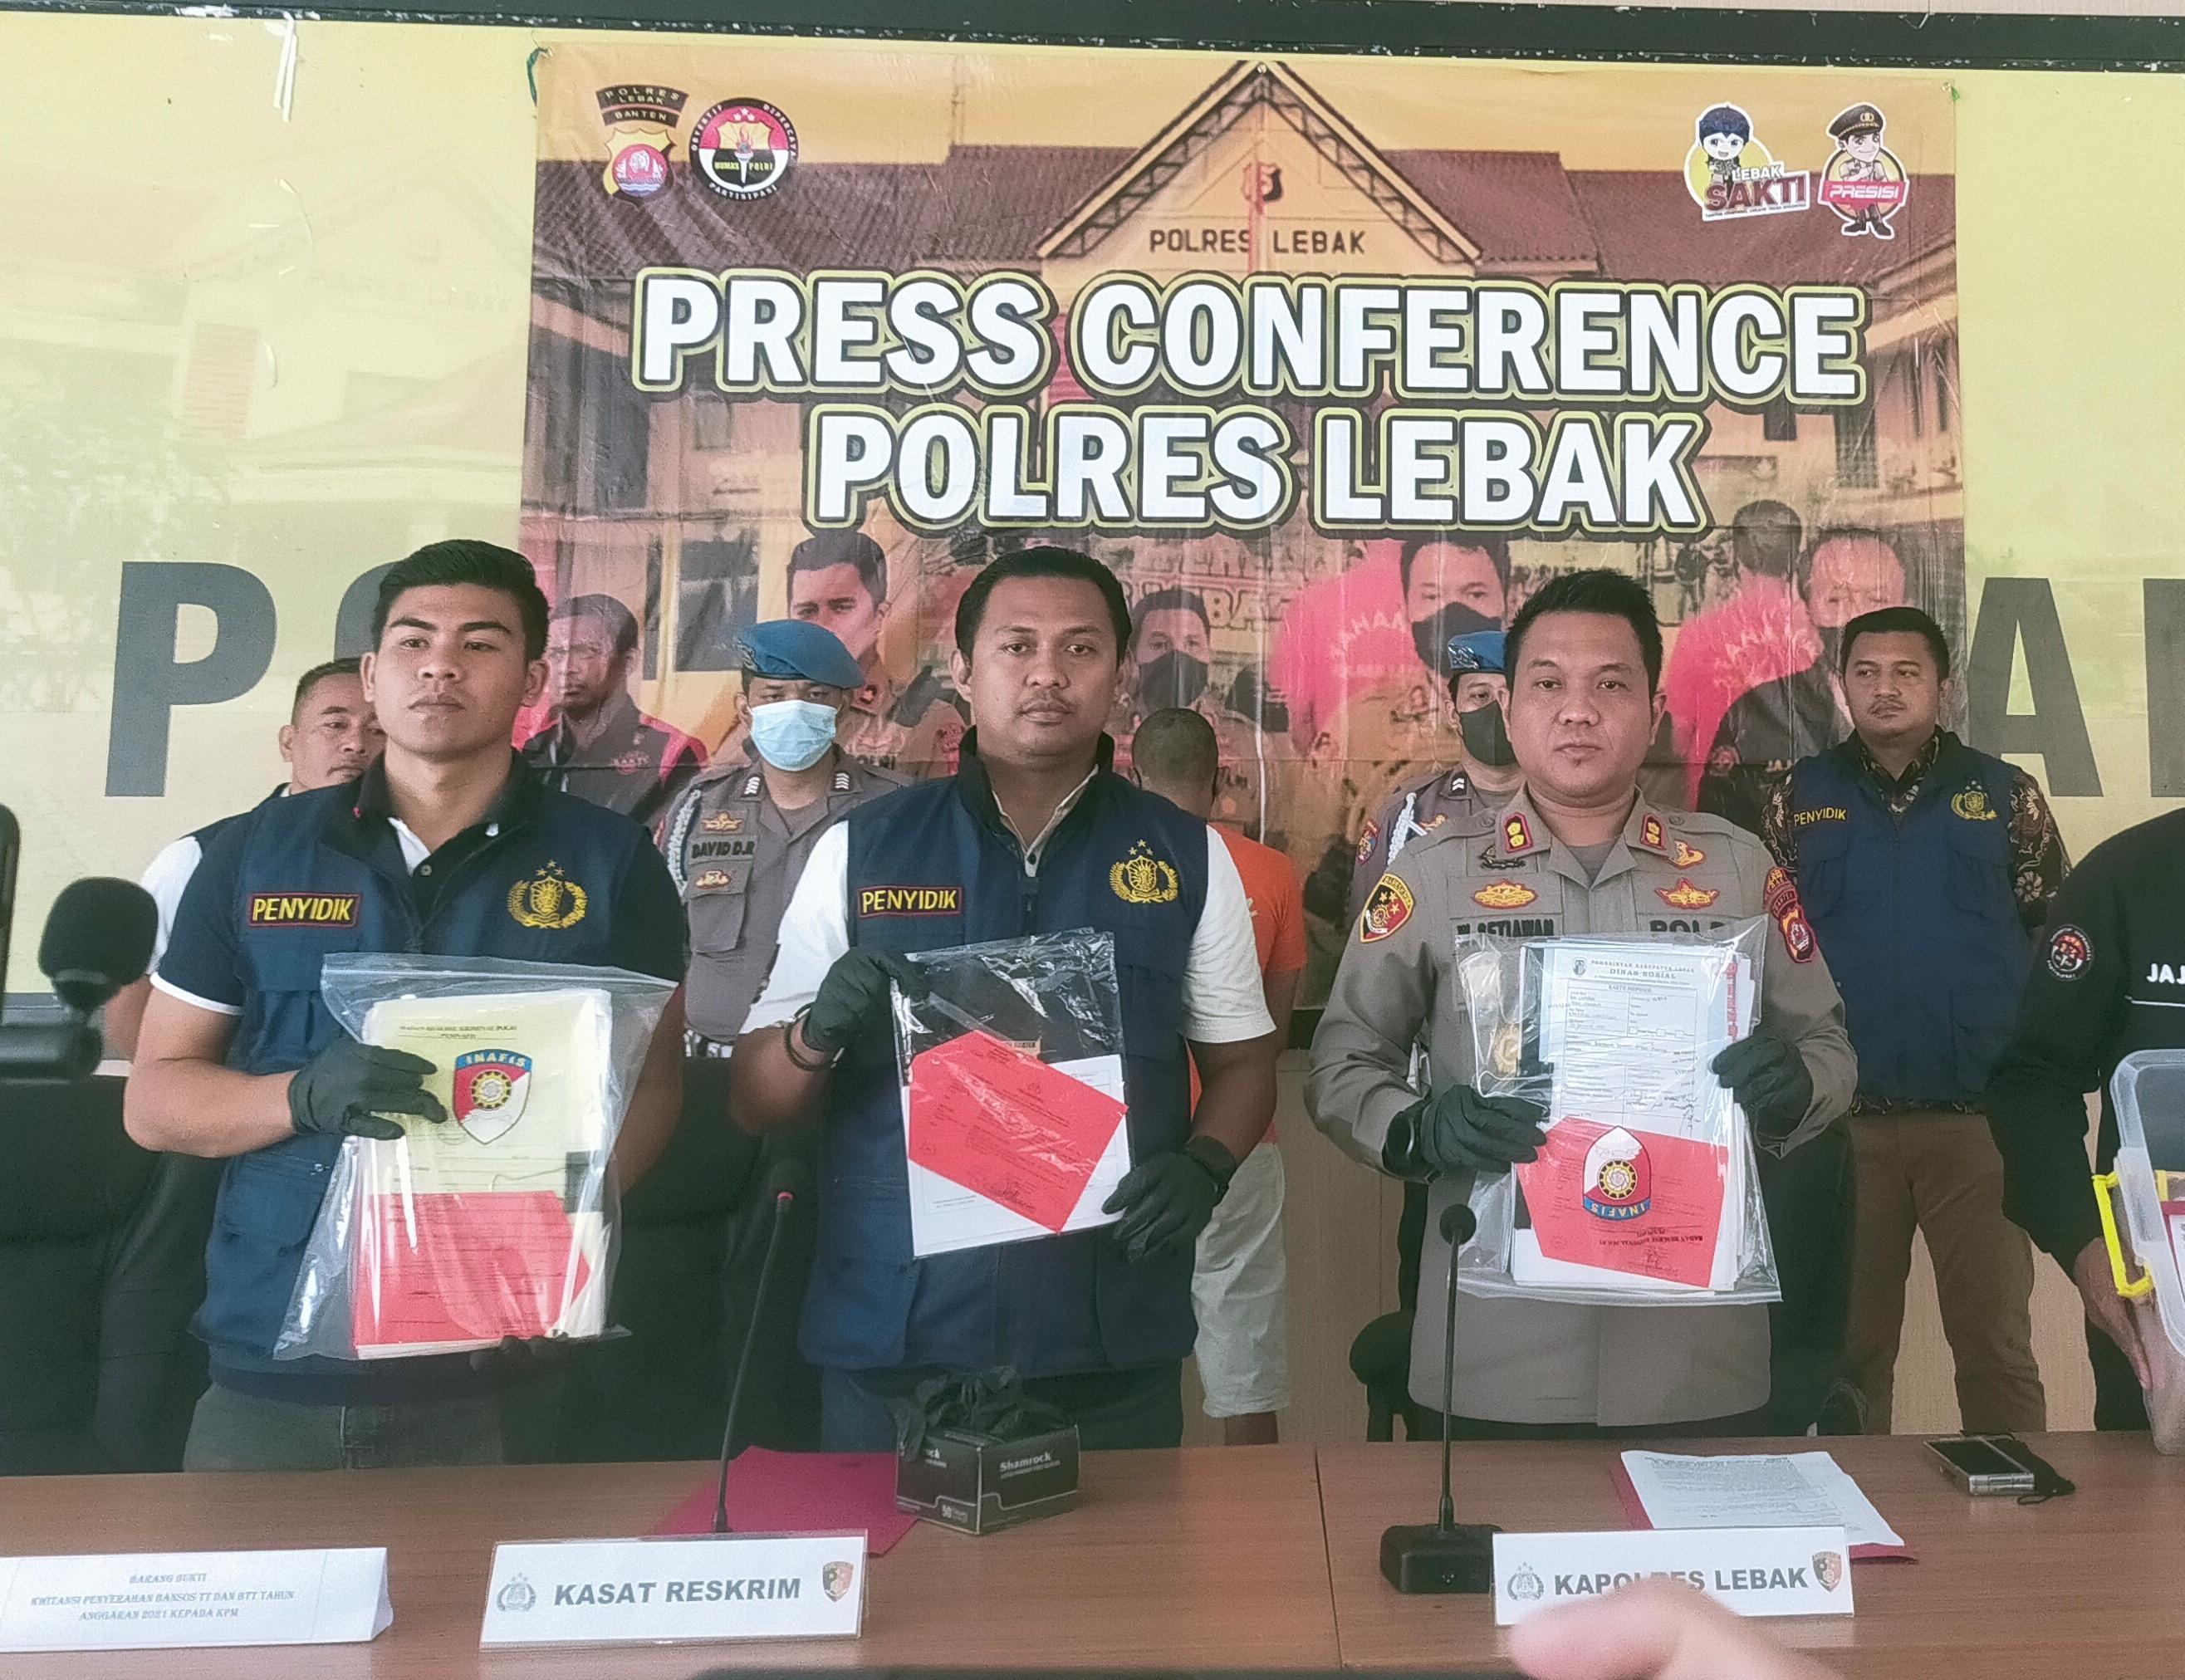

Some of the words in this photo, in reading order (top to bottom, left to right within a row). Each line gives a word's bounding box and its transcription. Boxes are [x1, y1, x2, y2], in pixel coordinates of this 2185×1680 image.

[605, 87, 679, 100] POLRES
[619, 96, 664, 105] LEBAK
[615, 110, 667, 120] BANTEN
[1732, 165, 1782, 182] LEBAK
[1705, 173, 1807, 212] SAKTI
[1830, 184, 1899, 200] PRESISI
[1149, 229, 1251, 253] POLRES
[1273, 229, 1366, 254] LEBAK
[638, 272, 1051, 392] PRESS
[1076, 276, 1860, 400] CONFERENCE
[814, 410, 1286, 525] POLRES
[1321, 414, 1703, 528] LEBAK
[1793, 807, 1847, 827] PENYIDIK
[691, 841, 731, 859] DAVID
[252, 897, 354, 922] PENYIDIK
[862, 889, 958, 913] PENYIDIK
[465, 1052, 526, 1066] INAFIS
[1591, 1202, 1646, 1218] INAFIS
[999, 1451, 1052, 1472] Shamrock
[1715, 1566, 1810, 1590] LEBAK
[213, 1592, 236, 1601] DAN
[260, 1590, 294, 1600] TAHUN
[554, 1581, 656, 1605] KASAT
[665, 1578, 801, 1603] RESKRIM
[169, 1609, 213, 1619] KEPADA
[216, 1608, 239, 1618] KPM
